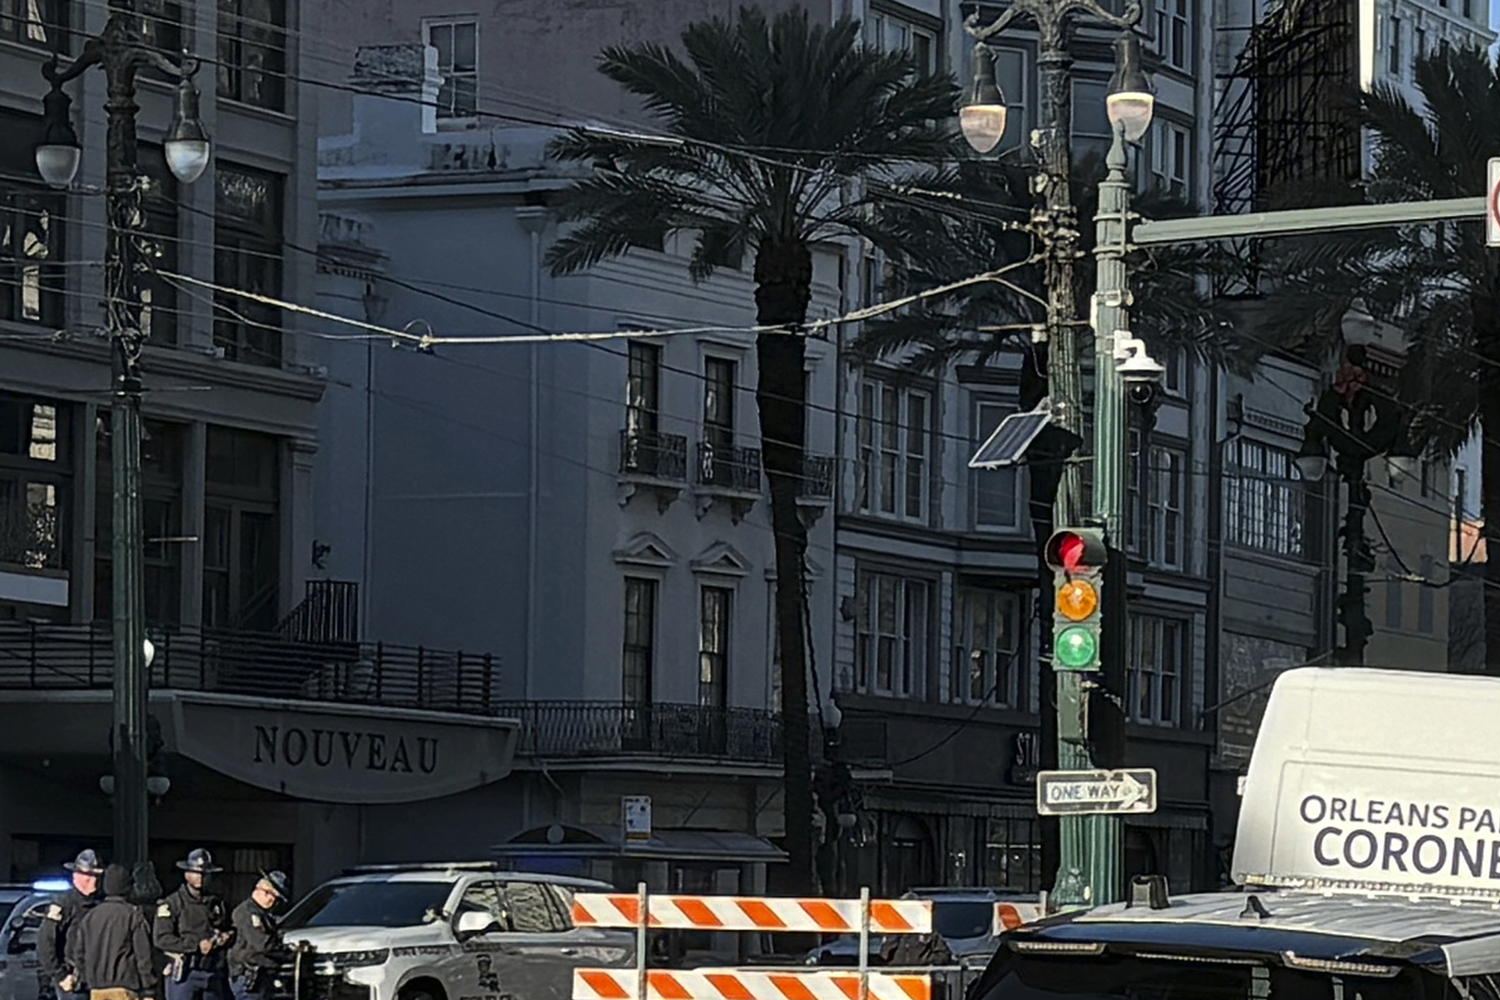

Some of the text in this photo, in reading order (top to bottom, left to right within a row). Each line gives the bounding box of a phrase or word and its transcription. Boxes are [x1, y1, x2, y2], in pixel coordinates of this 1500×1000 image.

[253, 725, 439, 775] NOUVEAU
[1051, 783, 1120, 801] ONE WAY
[1300, 794, 1449, 829] ORLEANS
